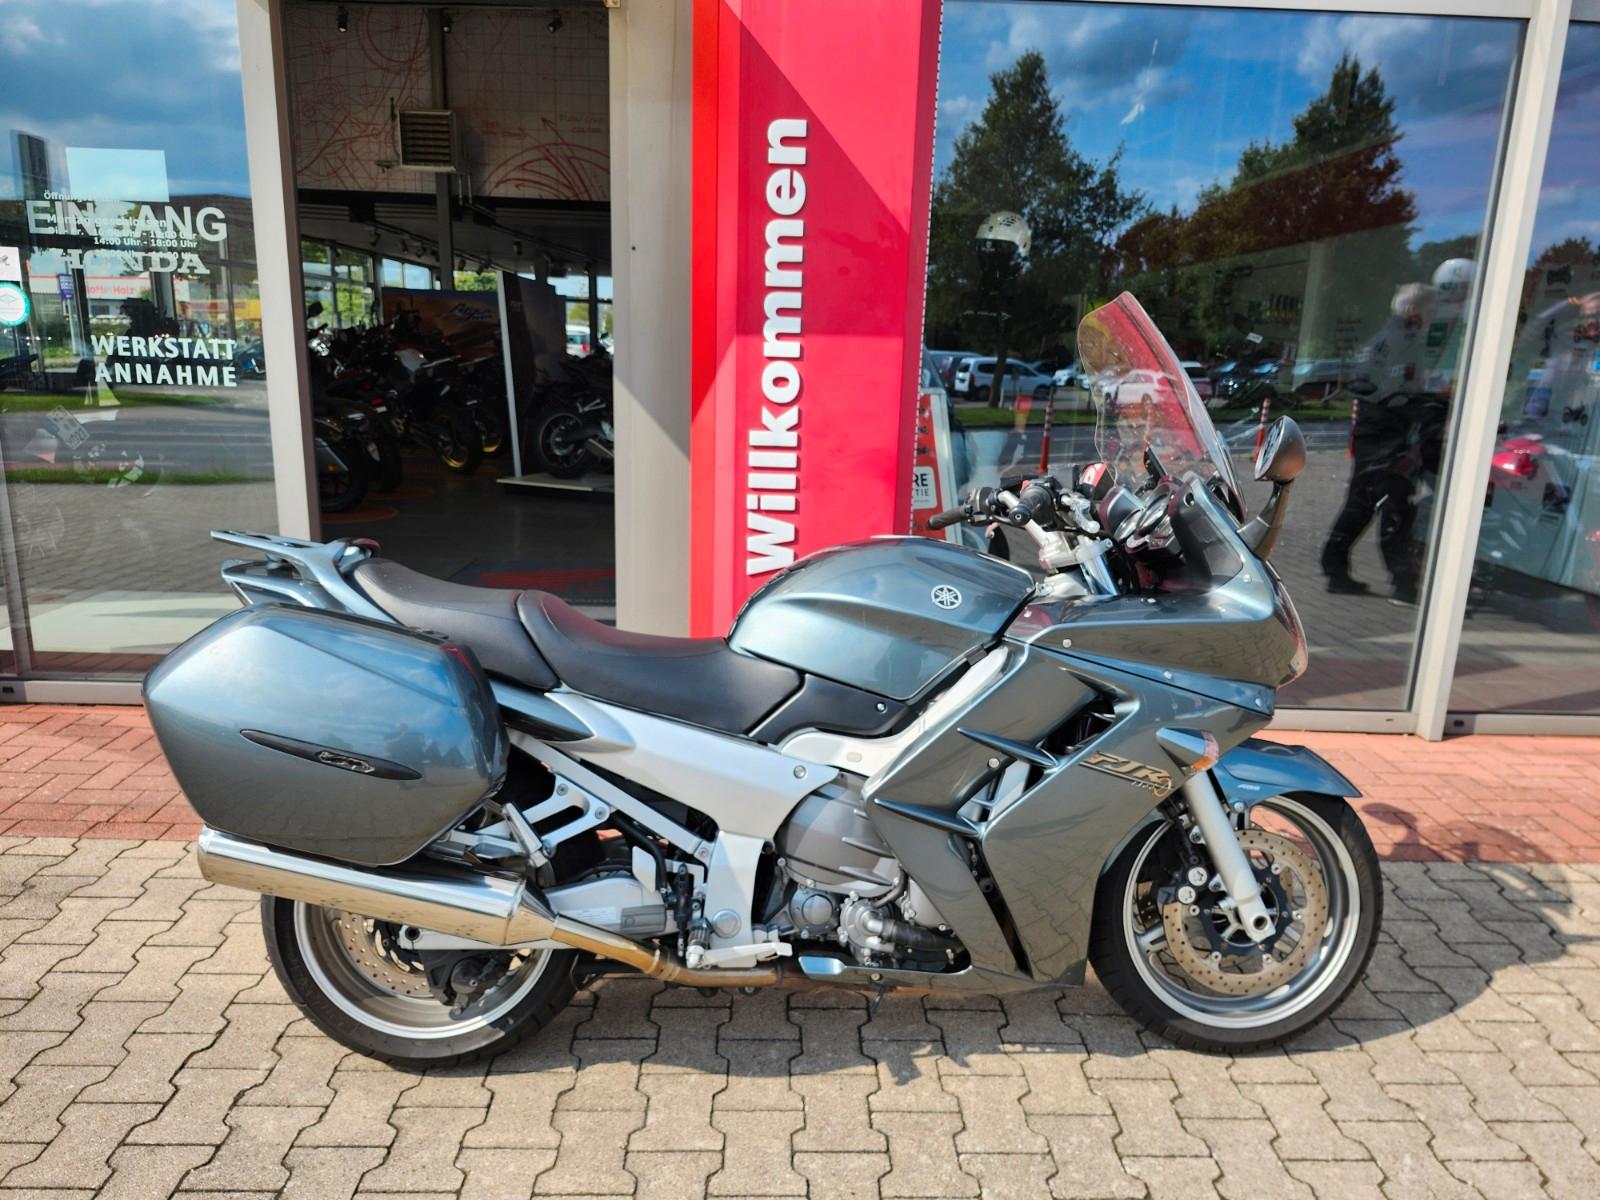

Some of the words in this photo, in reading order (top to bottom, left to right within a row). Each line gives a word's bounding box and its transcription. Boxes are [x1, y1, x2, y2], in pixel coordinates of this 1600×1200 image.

[180, 239, 198, 249] Uhr
[90, 334, 236, 360] WERKSTATT
[746, 118, 808, 576] Willkommen
[95, 362, 237, 387] ANNAHME
